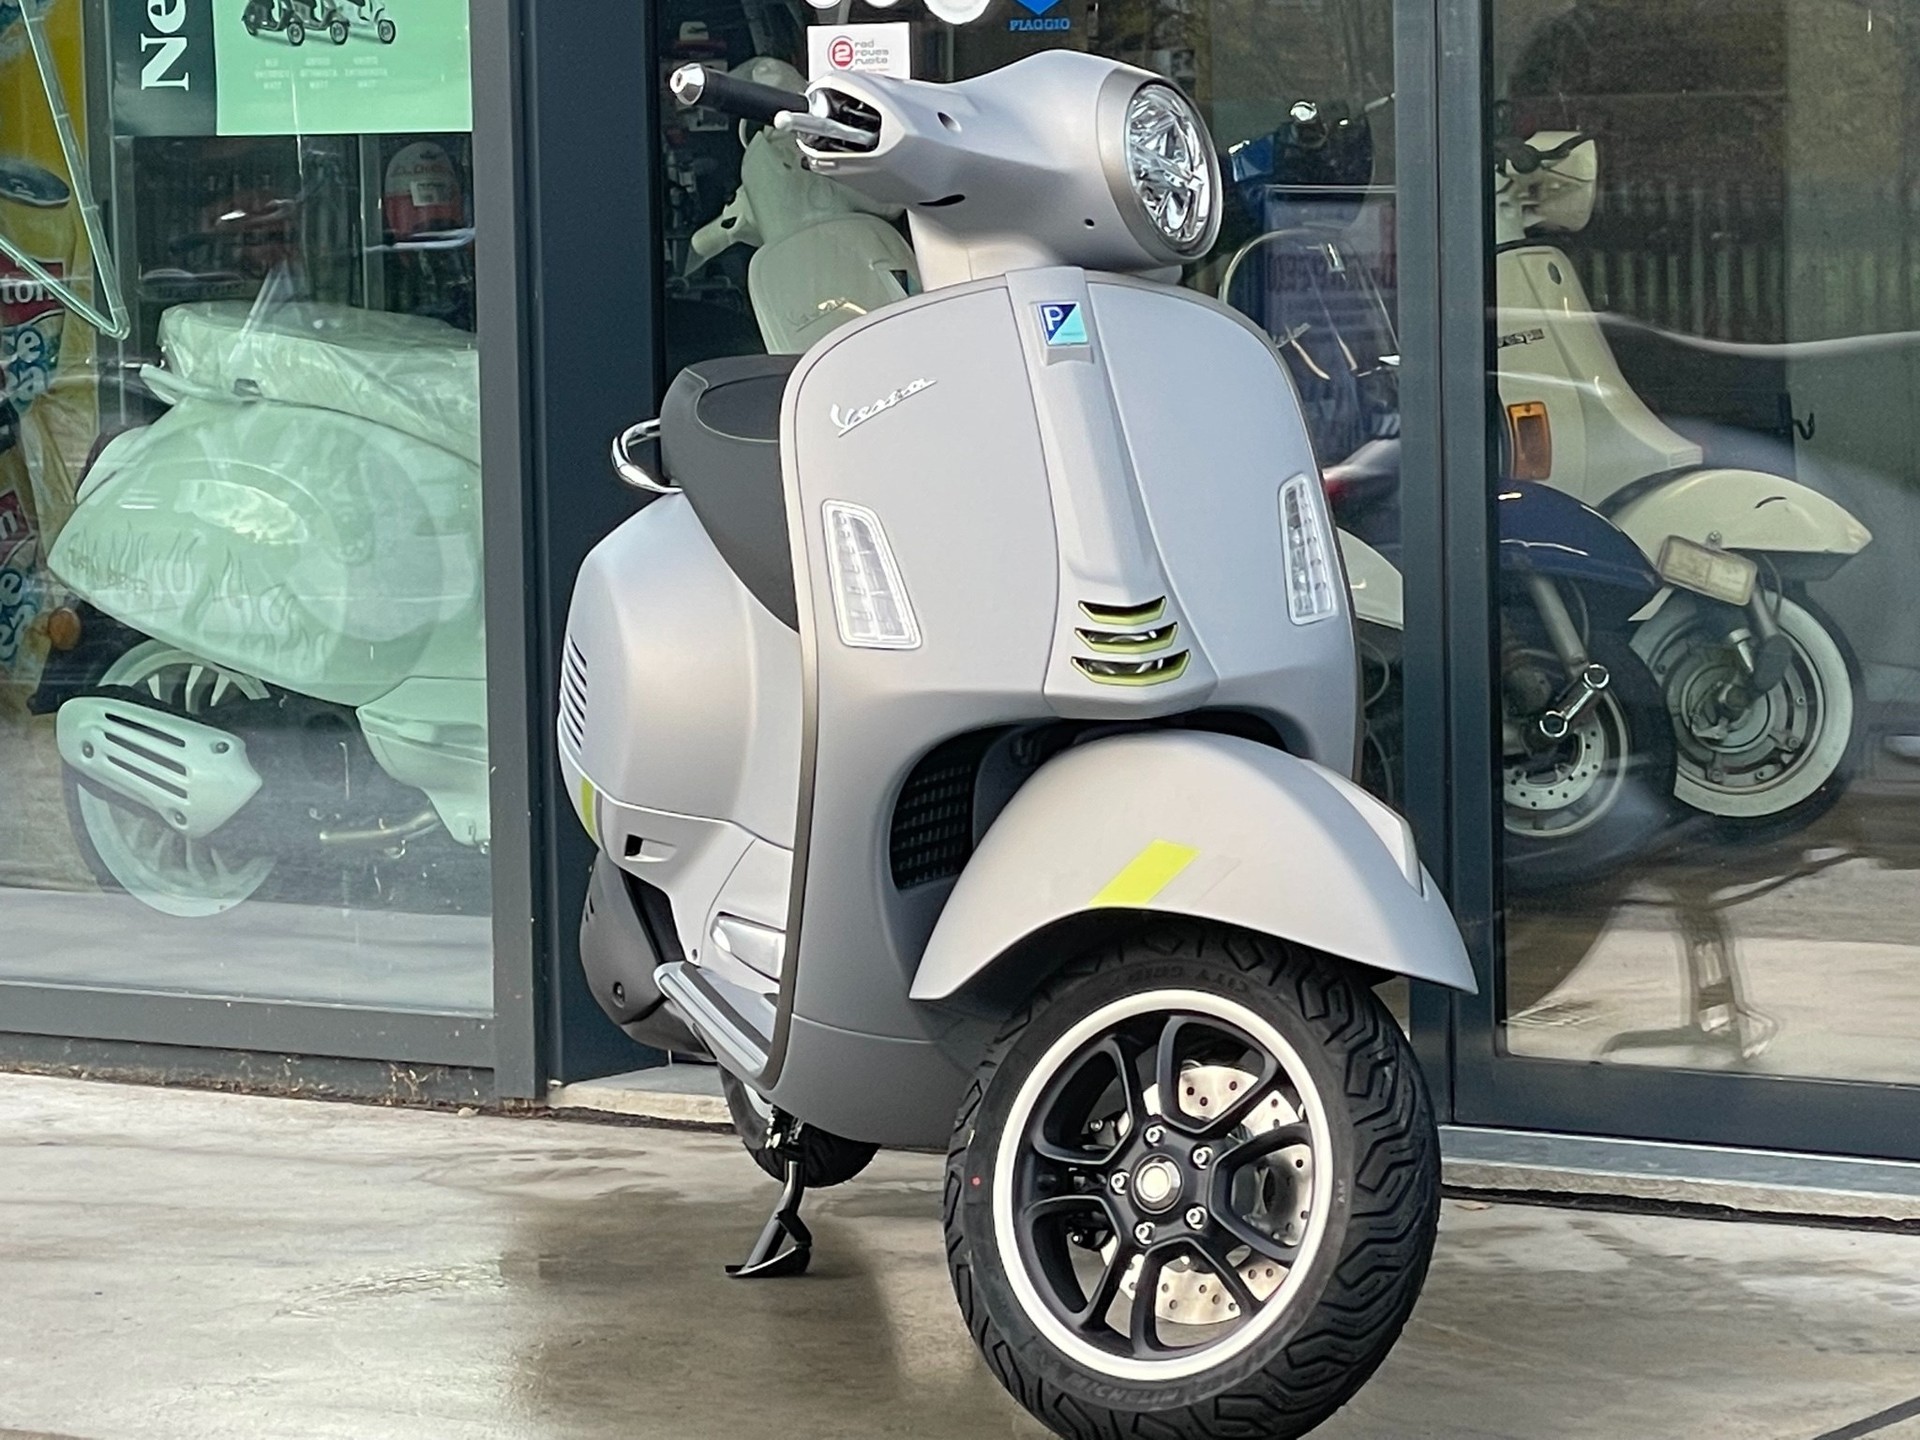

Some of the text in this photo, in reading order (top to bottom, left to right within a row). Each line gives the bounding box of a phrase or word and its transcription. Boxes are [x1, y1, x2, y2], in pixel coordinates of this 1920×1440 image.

[1009, 18, 1071, 31] PIAGGIO
[1043, 306, 1064, 331] P
[830, 378, 938, 438] Vespa
